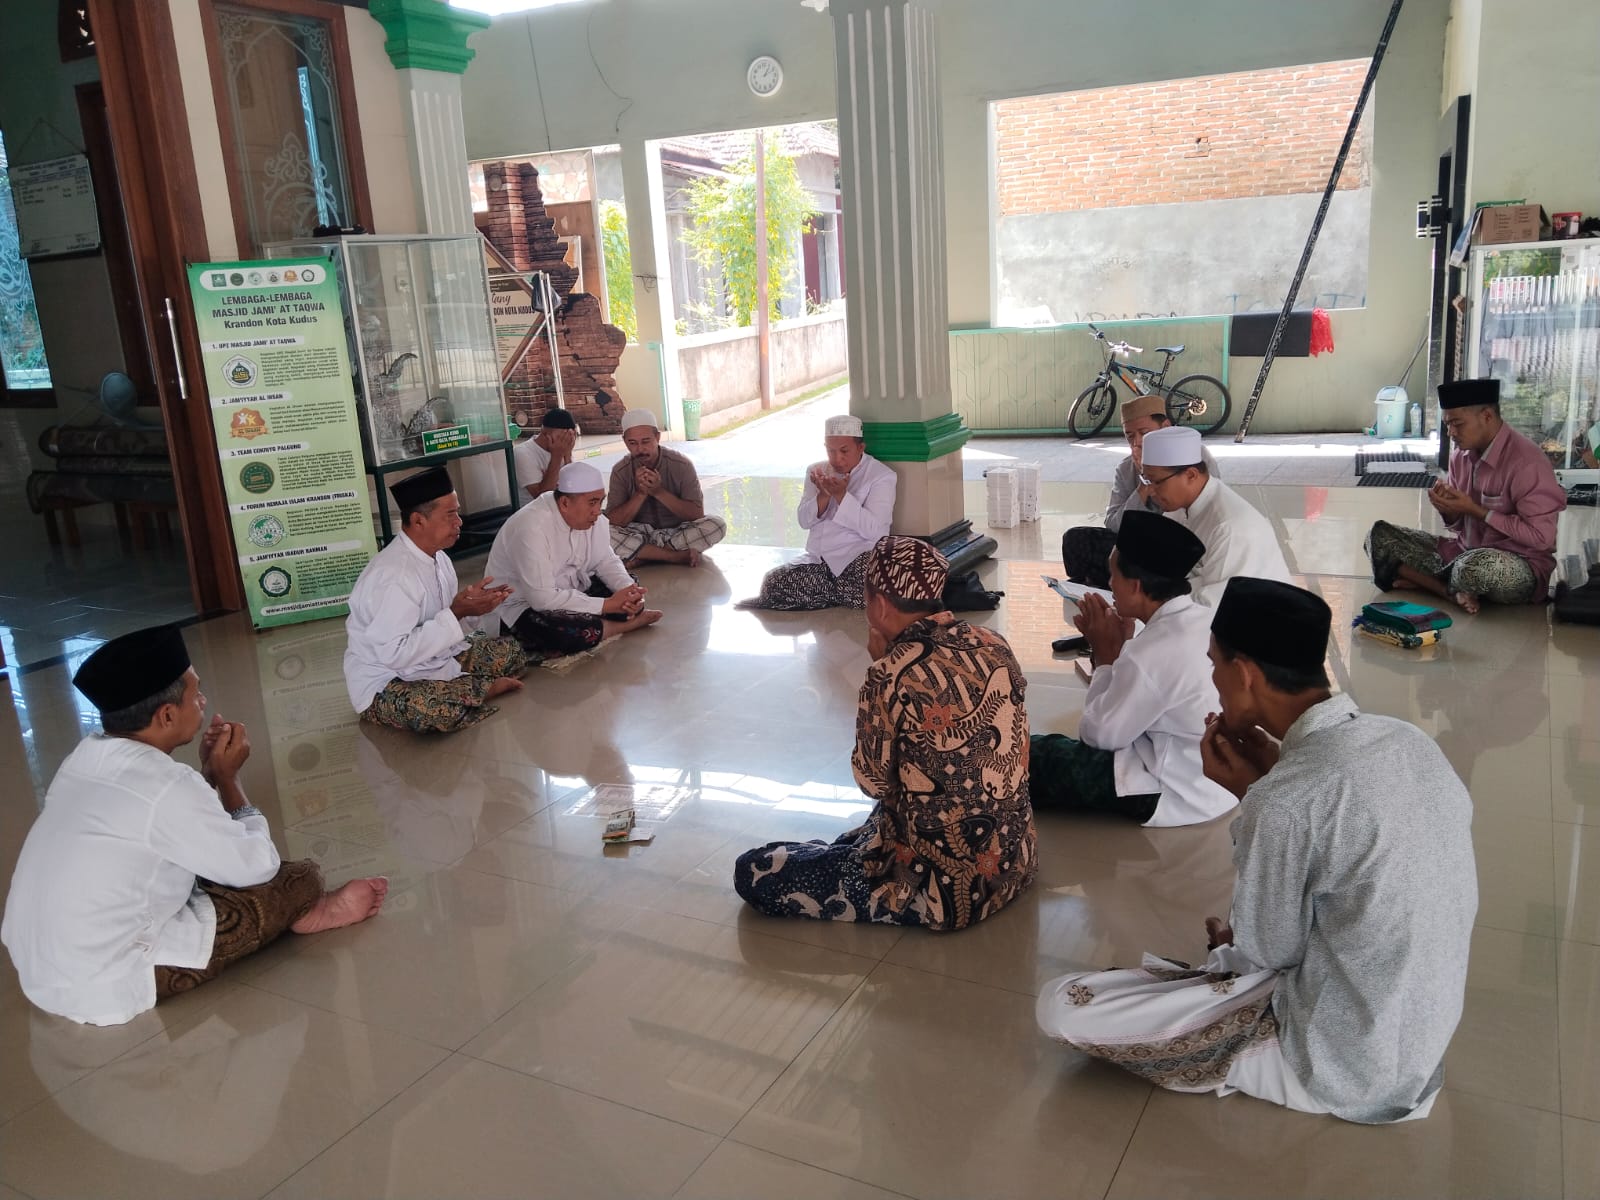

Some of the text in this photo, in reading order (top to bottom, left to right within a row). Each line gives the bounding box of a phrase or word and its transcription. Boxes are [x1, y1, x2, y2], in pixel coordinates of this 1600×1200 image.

[222, 291, 312, 305] LEMBAGA-LEMBAGA
[212, 308, 248, 318] MASJID
[279, 304, 291, 313] AT
[294, 302, 325, 313] TAQWA
[224, 315, 318, 329] Krandon Kota Kudus
[278, 337, 296, 345] TAQWA
[267, 500, 288, 508] REMAJA
[306, 494, 331, 502] KRANDON
[306, 545, 328, 554] RAHMAN
